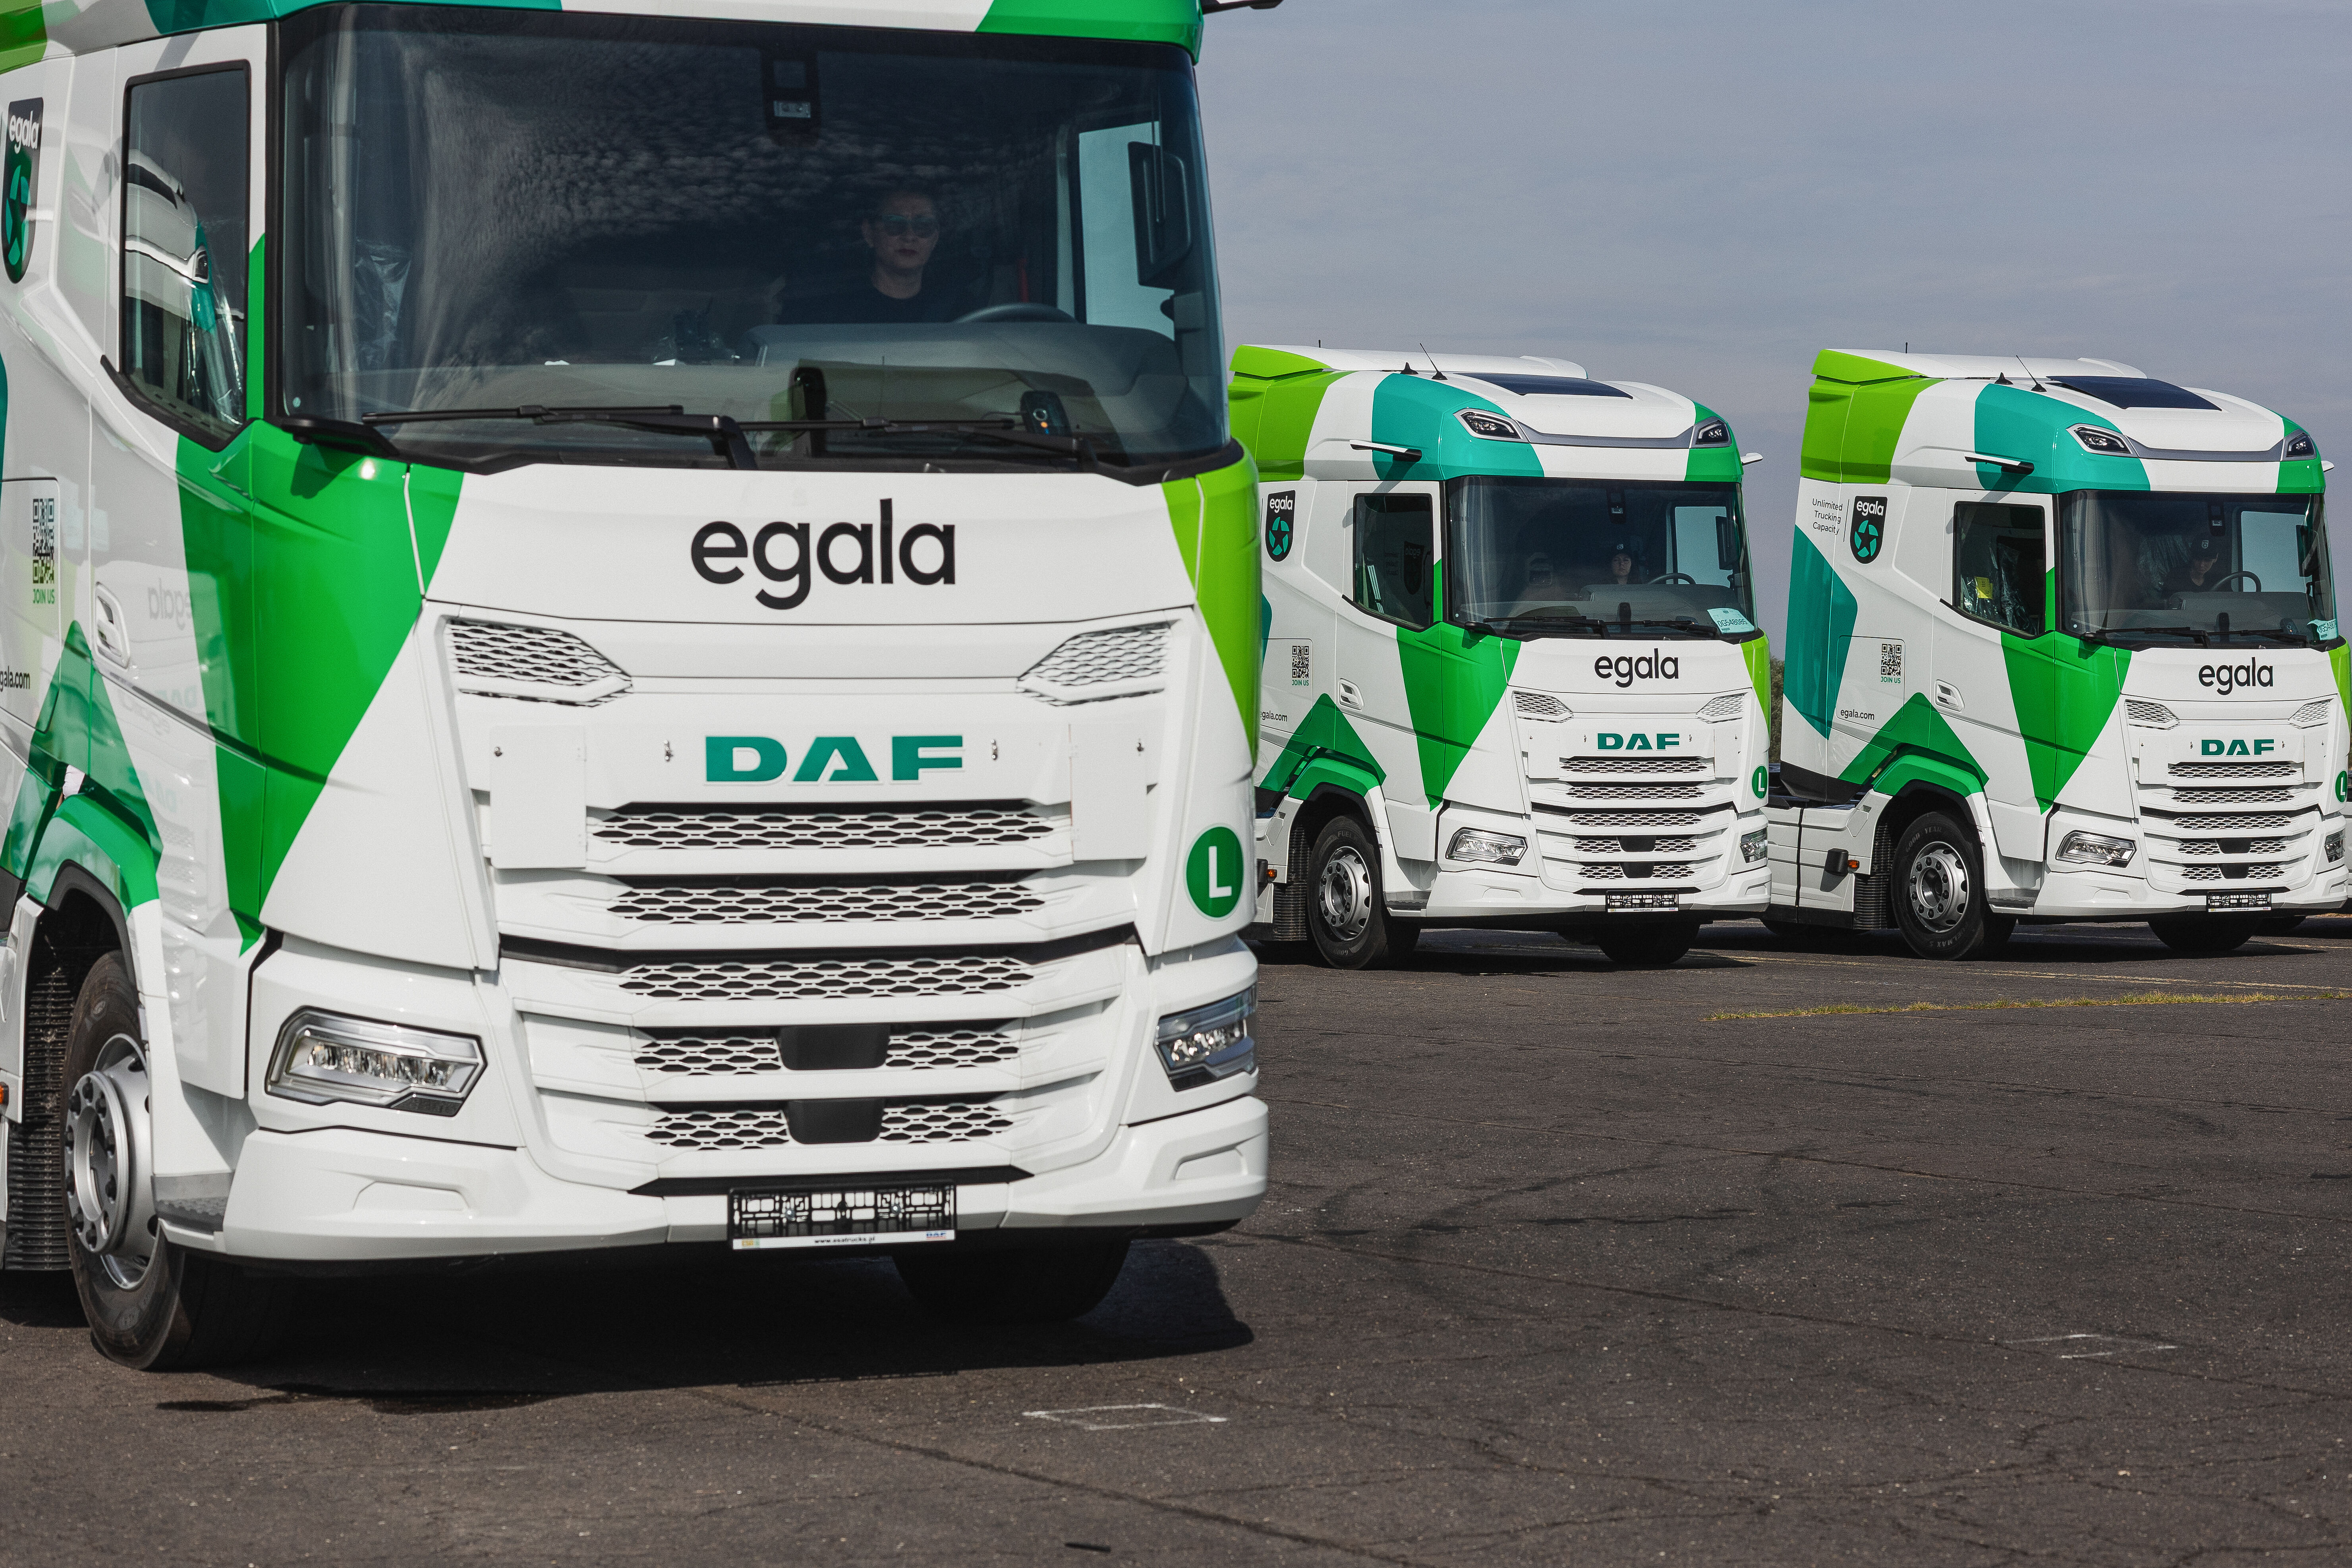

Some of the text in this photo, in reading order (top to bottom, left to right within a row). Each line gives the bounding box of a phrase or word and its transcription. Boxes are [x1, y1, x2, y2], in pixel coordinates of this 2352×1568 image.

[9, 110, 39, 154] egala
[1270, 496, 1293, 513] egala
[1812, 498, 1843, 511] Unlimited
[1857, 501, 1884, 516] egala
[1815, 510, 1841, 524] Trucking
[1813, 522, 1840, 536] Capacity
[691, 498, 955, 610] egala
[33, 589, 55, 604] JOIN US
[1594, 648, 1679, 688] egala
[2198, 657, 2273, 696] egala
[0, 665, 30, 692] gala.com
[1840, 709, 1875, 720] egala.com
[1597, 733, 1679, 750] DAF
[2201, 739, 2275, 756] DAF
[705, 735, 963, 782] DAF
[1758, 772, 1765, 792] L
[2340, 777, 2346, 795] L
[1208, 845, 1232, 898] L
